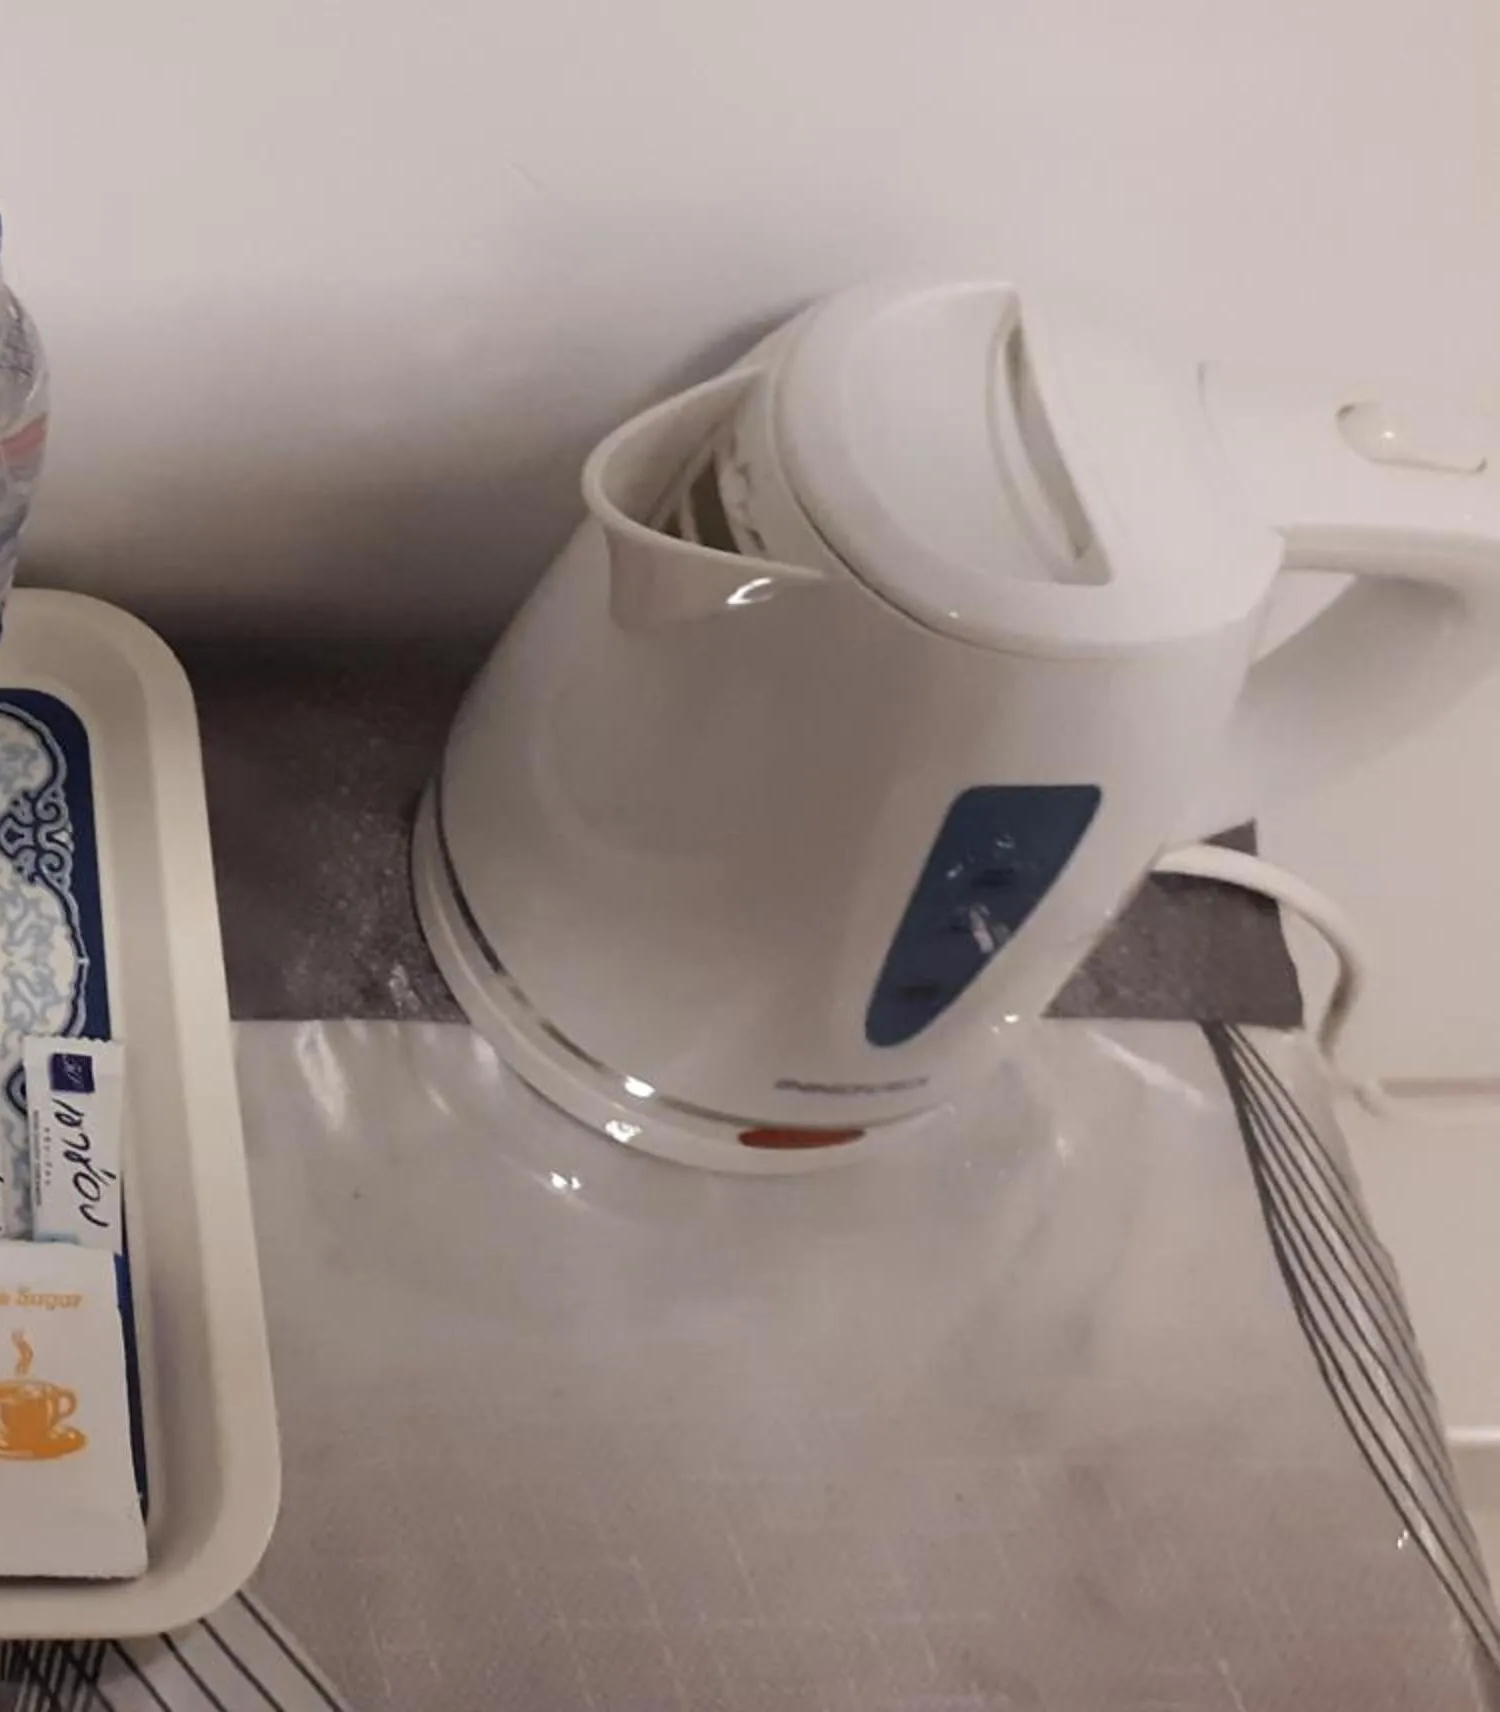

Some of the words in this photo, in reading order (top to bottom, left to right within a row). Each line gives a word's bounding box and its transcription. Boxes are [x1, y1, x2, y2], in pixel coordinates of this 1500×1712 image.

[52, 1099, 117, 1227] เขาช่อง
[16, 1286, 82, 1310] Sugar
